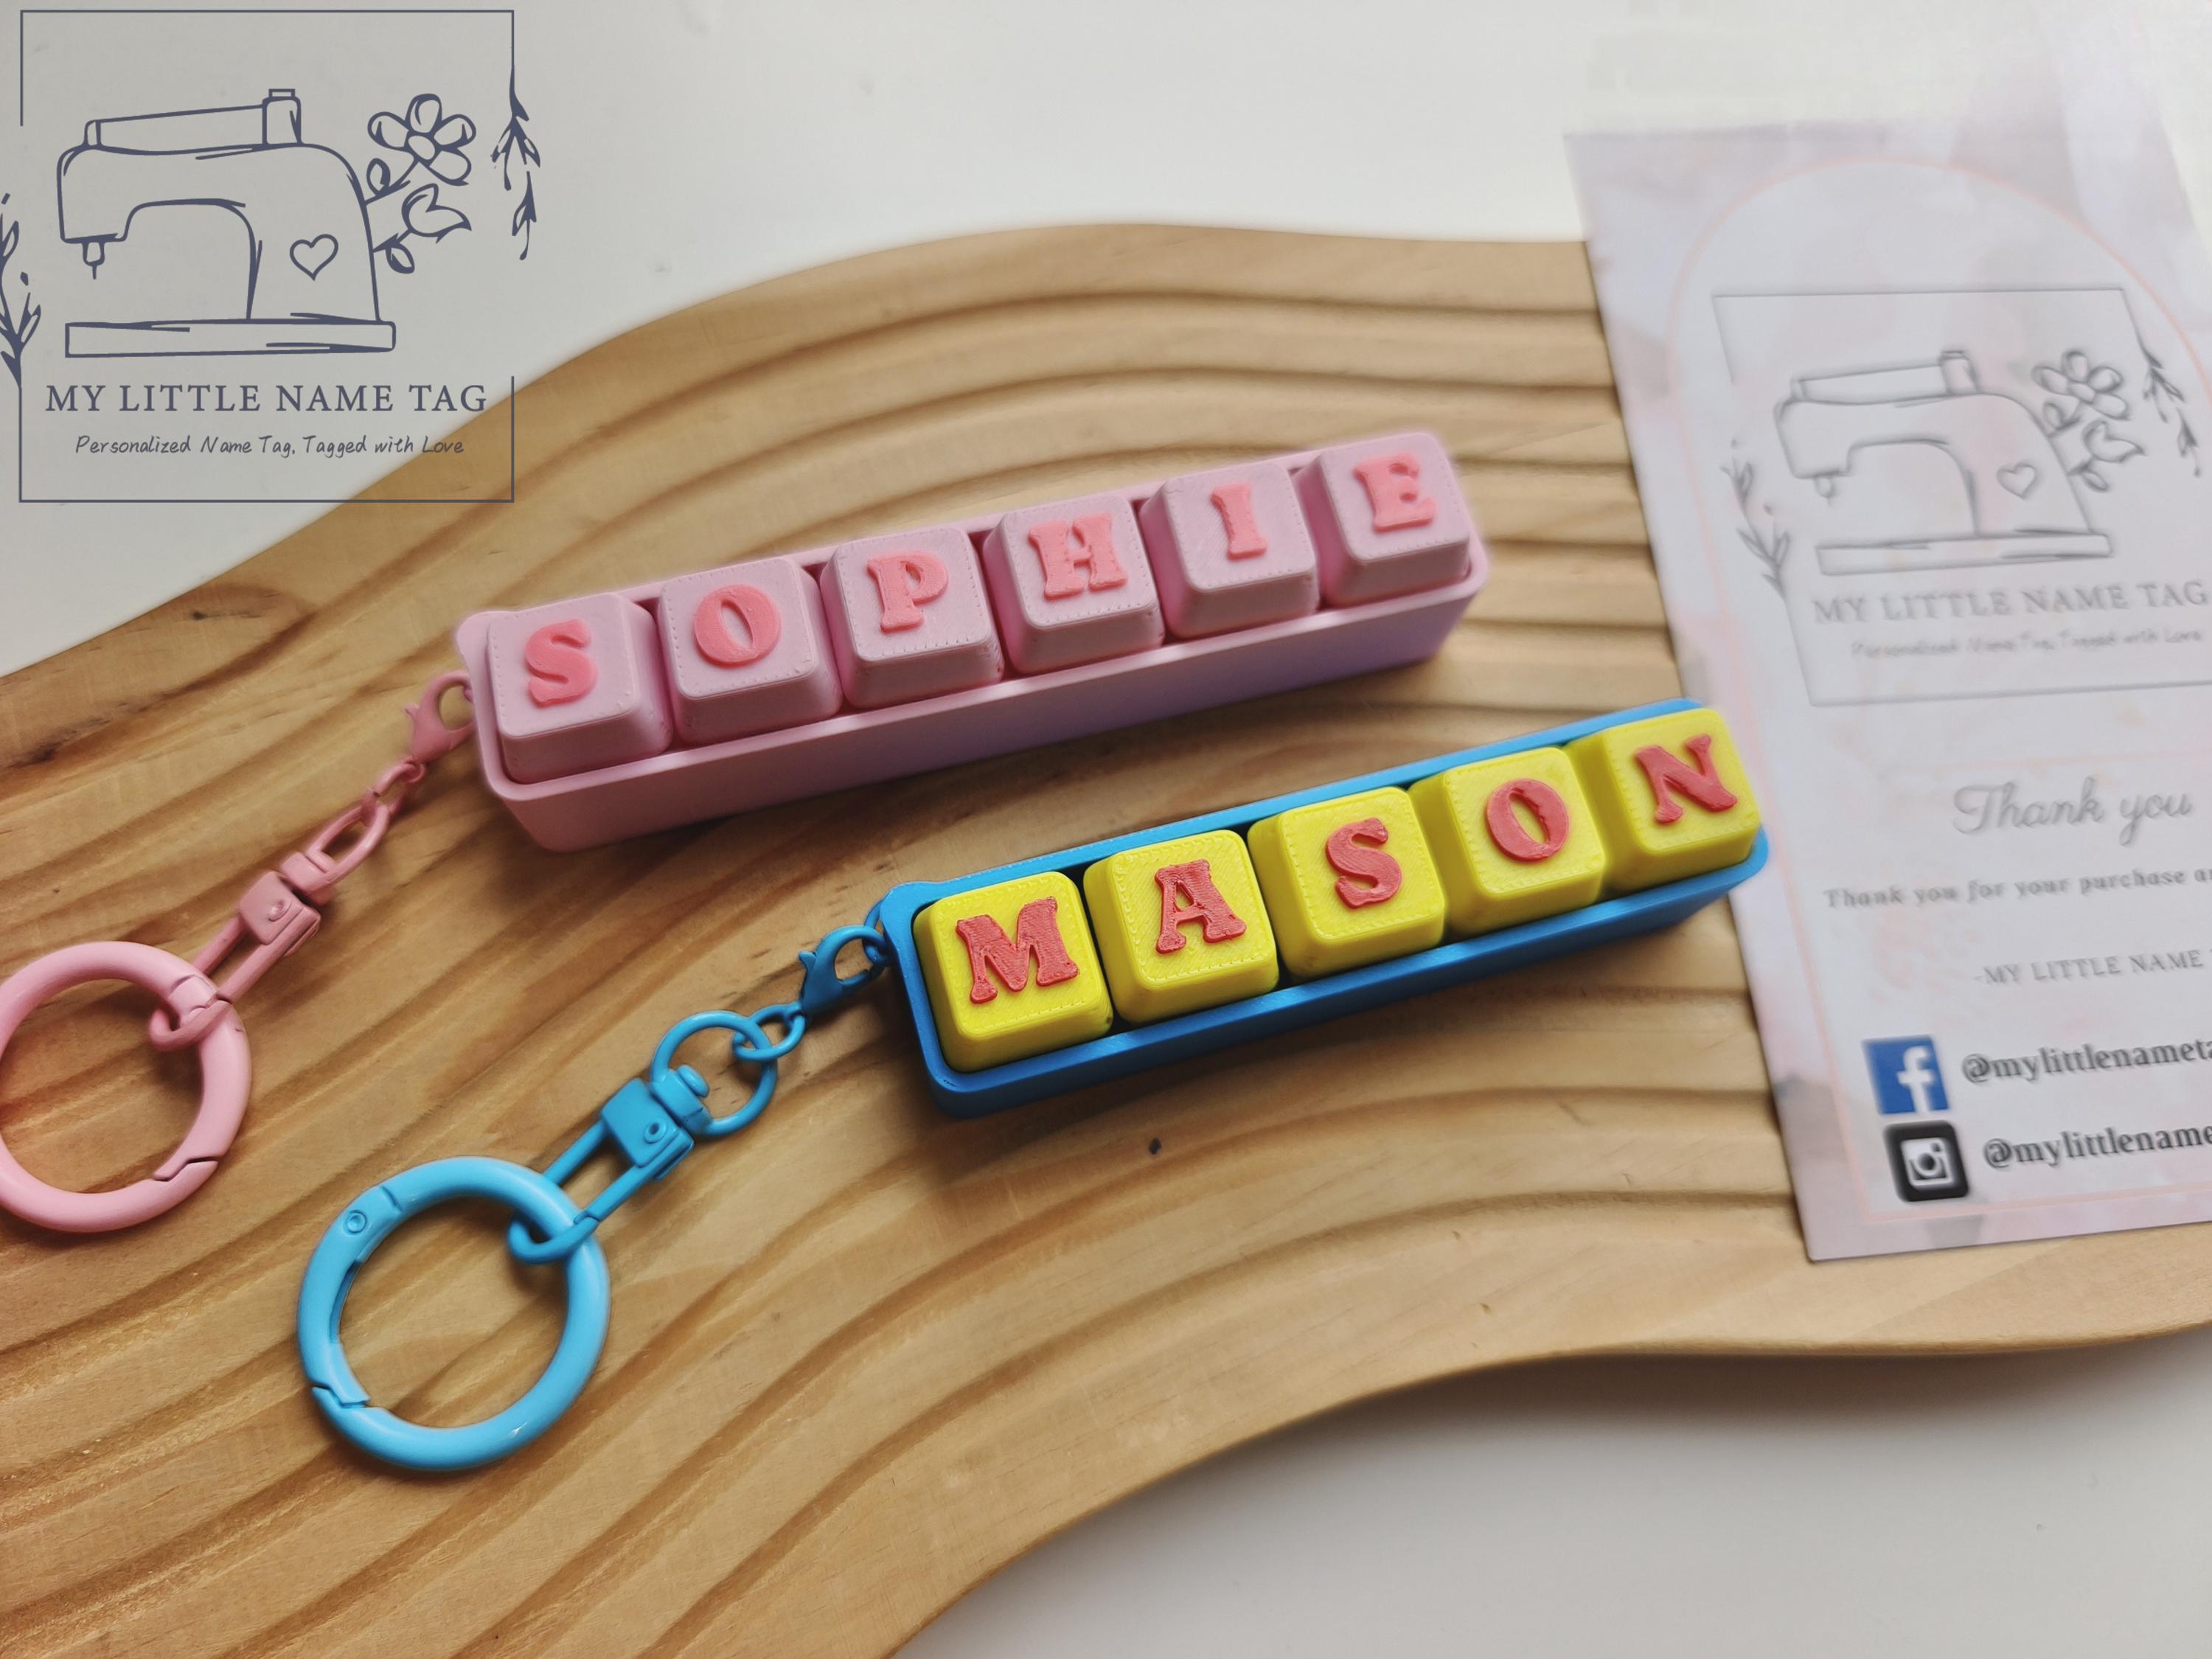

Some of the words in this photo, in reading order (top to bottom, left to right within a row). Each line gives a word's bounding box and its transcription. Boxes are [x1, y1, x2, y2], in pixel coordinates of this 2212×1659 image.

[523, 452, 1437, 708] SOPHIE
[1813, 597, 1867, 624] MY
[1879, 590, 2011, 621] LITTLE
[2020, 585, 2129, 614] NAME
[2136, 580, 2208, 607] TAG
[1952, 776, 2104, 835] Thank
[2119, 792, 2193, 846] you
[955, 734, 1739, 1005] MASON
[1823, 887, 1904, 908] Thank
[1913, 887, 1958, 907] you
[1967, 880, 2004, 902] for
[2014, 879, 2068, 900] your
[2079, 869, 2185, 896] purchase
[2030, 956, 2122, 982] LITTLE
[2128, 948, 2204, 973] NAME
